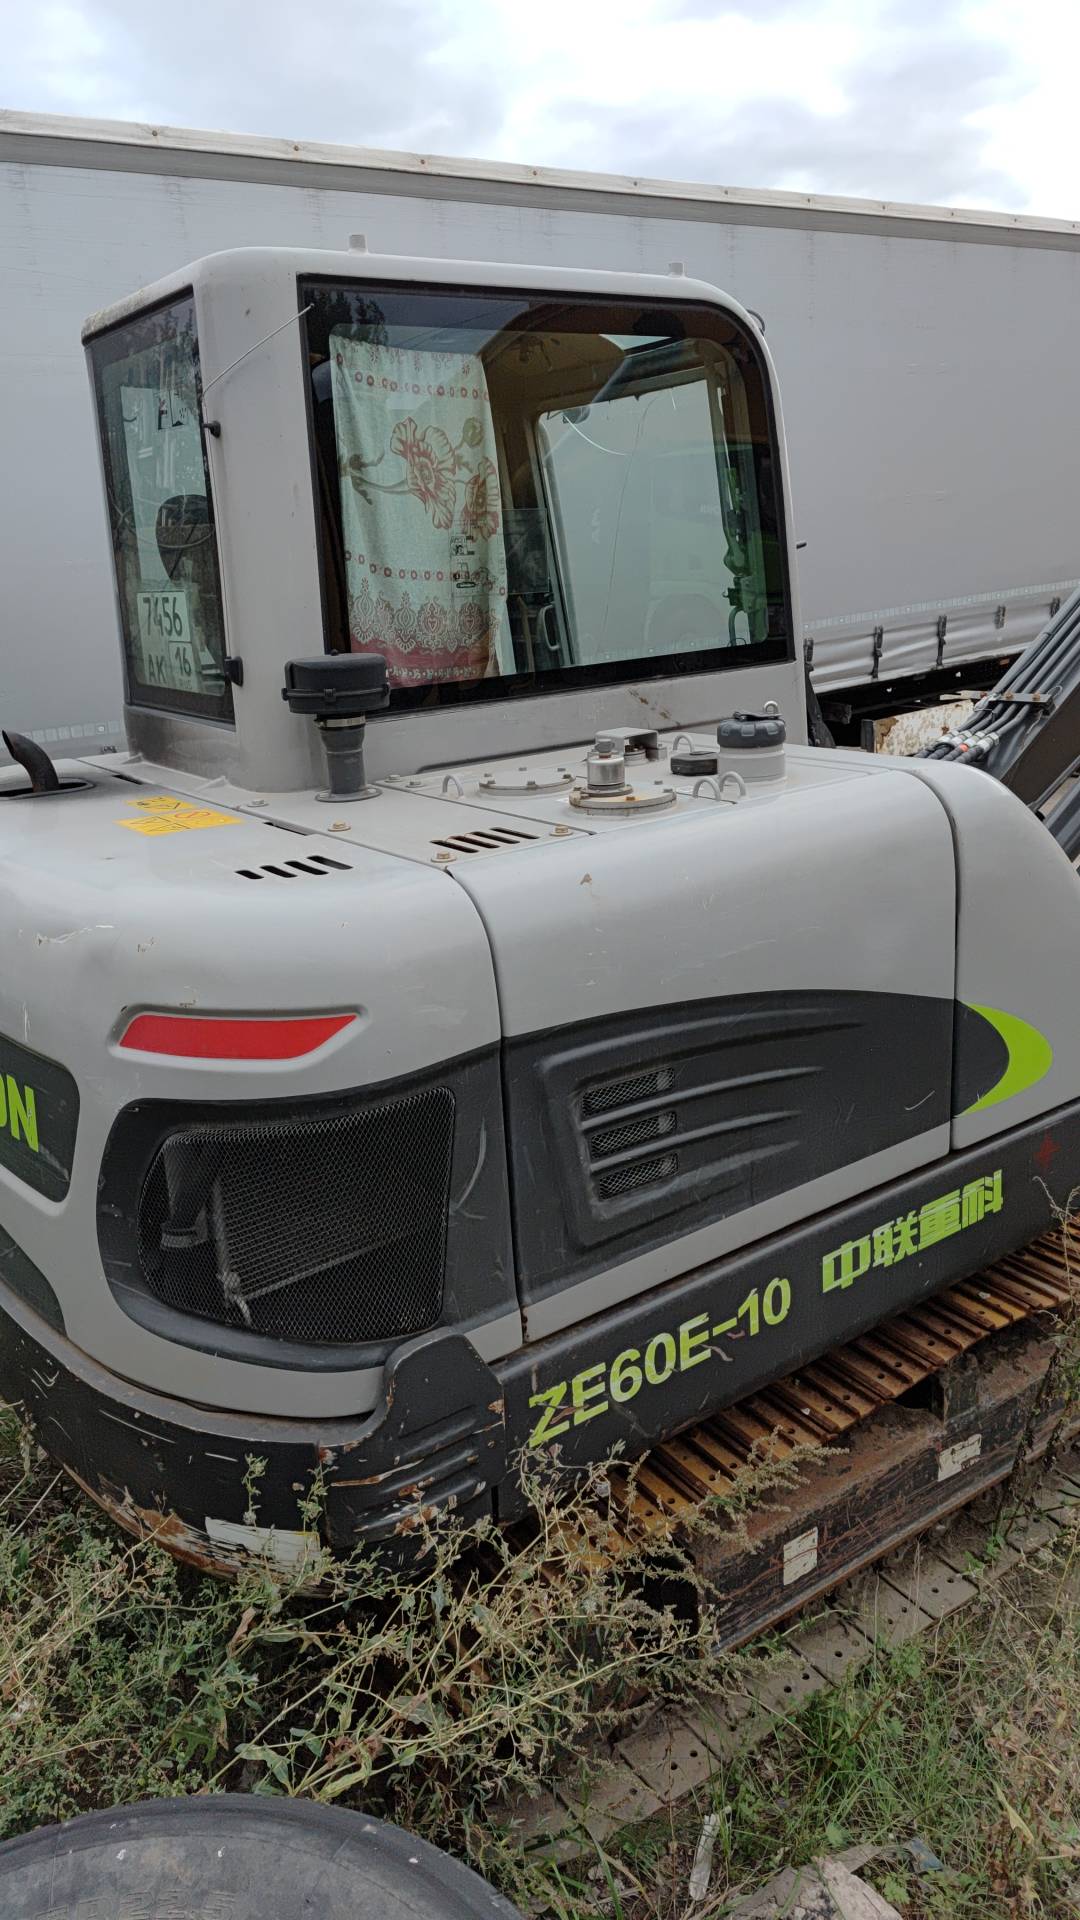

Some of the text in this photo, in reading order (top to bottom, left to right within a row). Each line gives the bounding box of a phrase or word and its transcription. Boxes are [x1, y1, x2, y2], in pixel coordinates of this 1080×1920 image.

[142, 596, 183, 636] 7456
[175, 647, 193, 677] 16
[822, 1168, 1004, 1293] 中联重科
[528, 1277, 792, 1448] ZE60E-10
